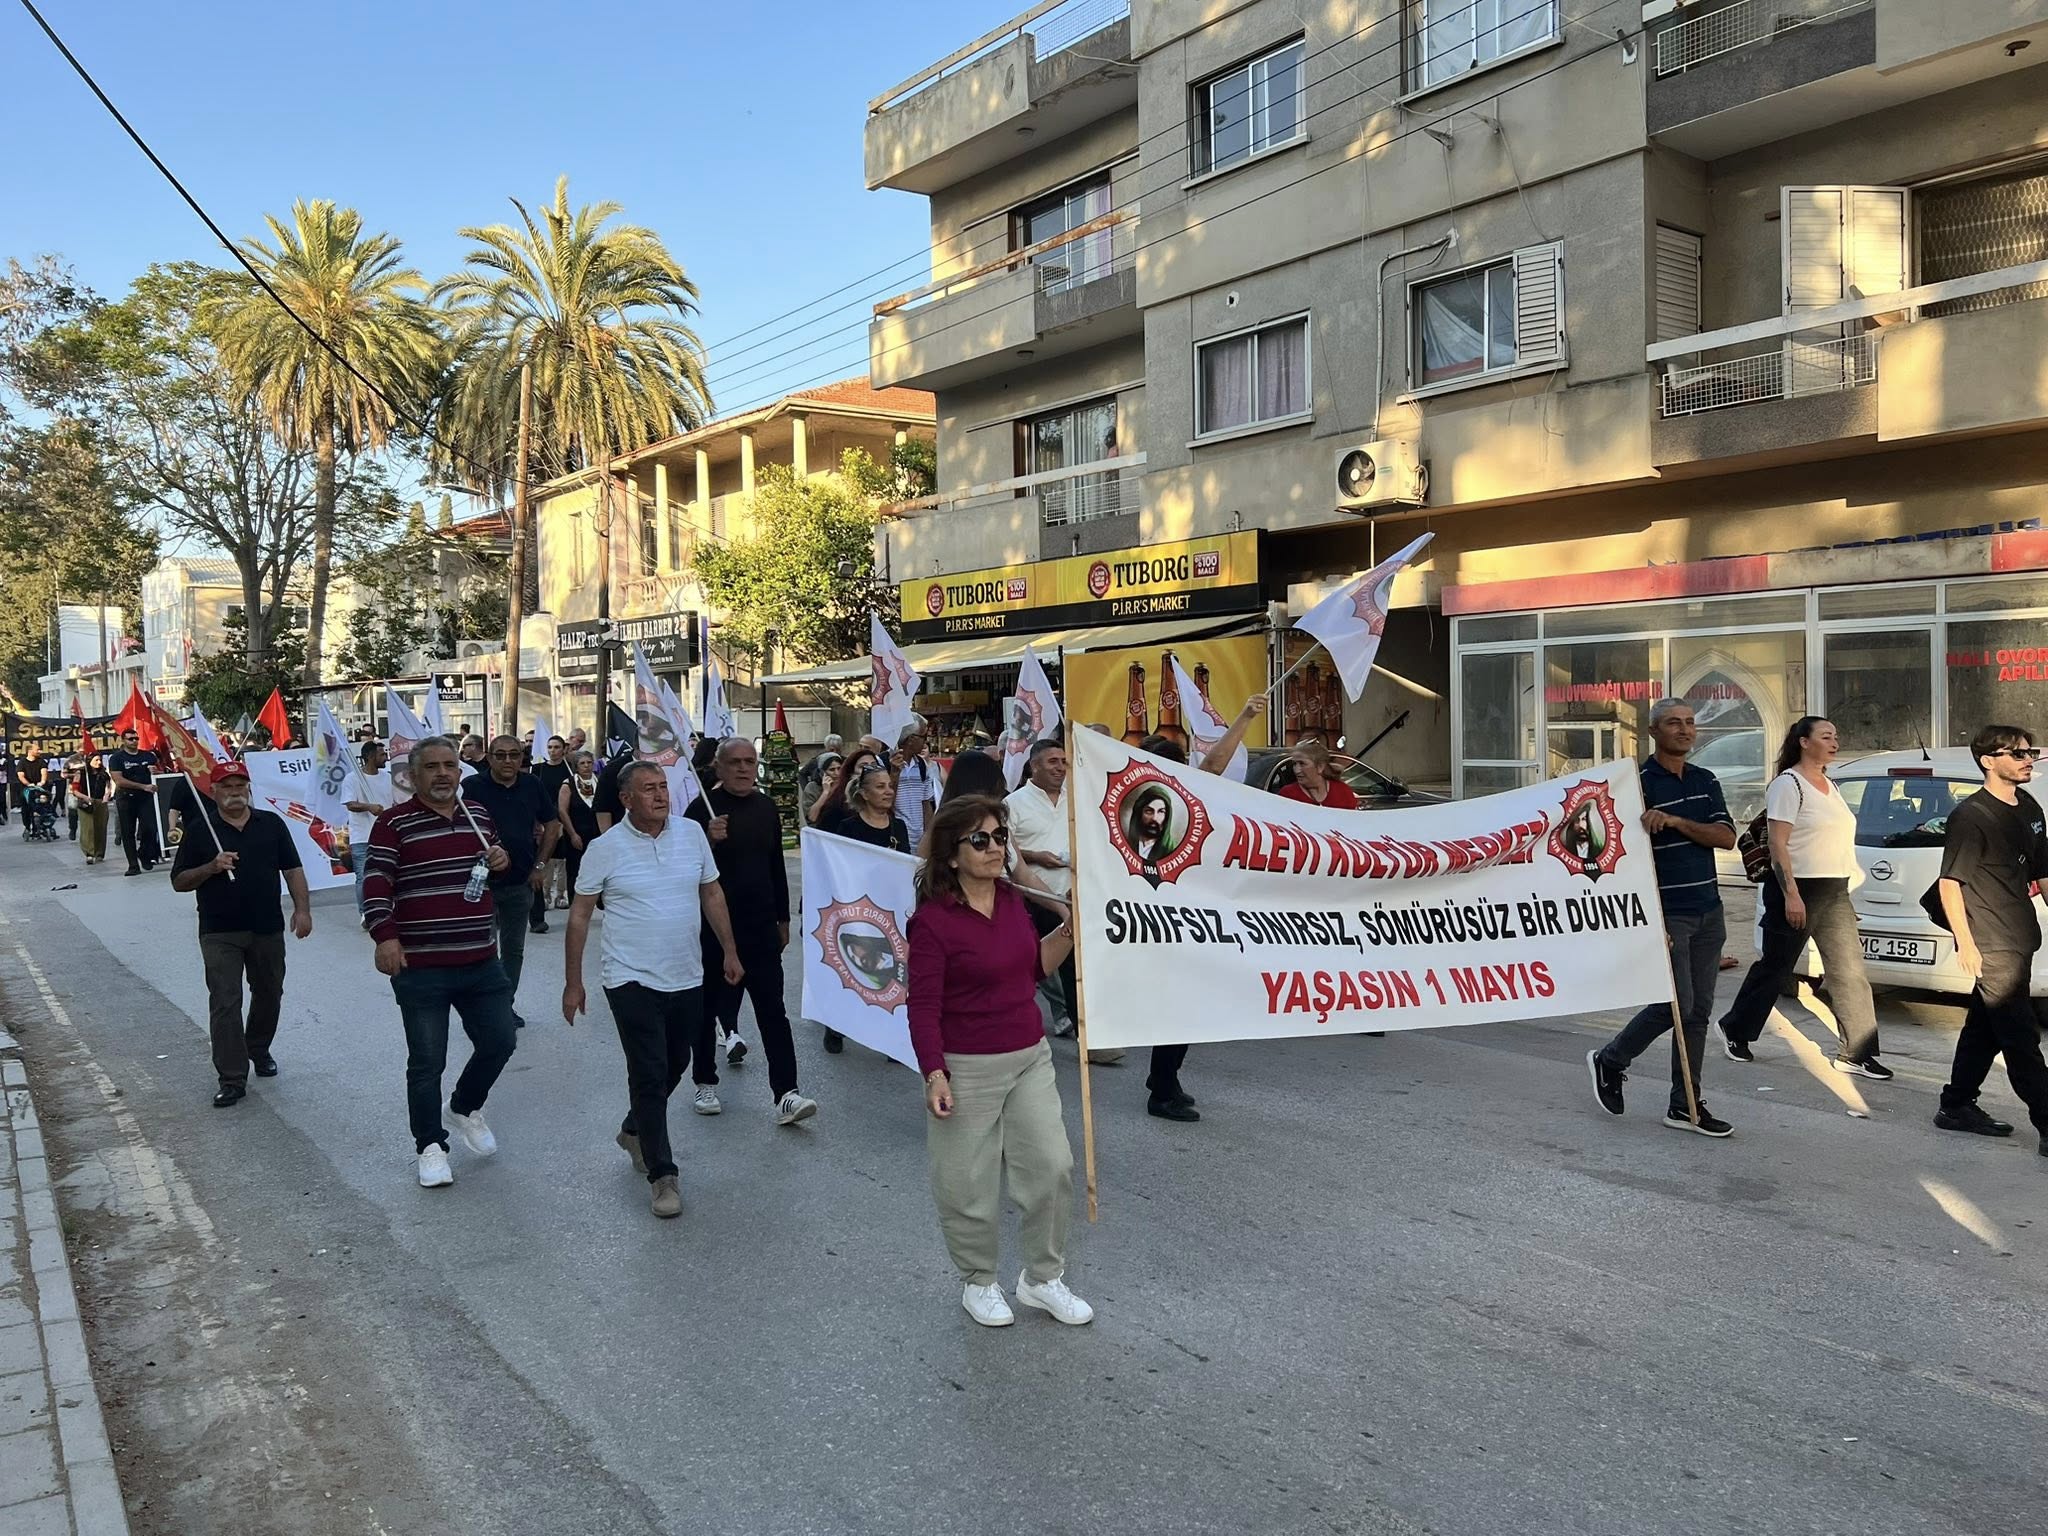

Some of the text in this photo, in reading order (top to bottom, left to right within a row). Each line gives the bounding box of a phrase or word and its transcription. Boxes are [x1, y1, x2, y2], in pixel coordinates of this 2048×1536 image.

[1113, 555, 1190, 588] TUBORG
[1197, 566, 1216, 575] MALT
[946, 580, 1004, 608] TUBORG
[1149, 594, 1191, 613] MARKET
[673, 616, 680, 635] 2
[974, 614, 1006, 630] MARKET
[561, 631, 587, 650] HALEP
[1107, 782, 1125, 808] TÜRK
[1107, 811, 1123, 845] KIBRIS
[1189, 805, 1206, 846] KÜLTÜR
[1120, 845, 1142, 871] KUZEY
[1314, 828, 1441, 880] KÜLTÜR
[1560, 852, 1582, 870] KUZEY
[1143, 864, 1158, 876] 1994
[1583, 862, 1599, 871] 1994
[1105, 888, 1649, 955] SINIFSIZ, SINIRSIZ, SÖMÜRÜSÜZ BİR DÜNYA
[1886, 940, 1918, 957] 158
[1260, 960, 1556, 1024] YAŞASIN 1 MAYIS
